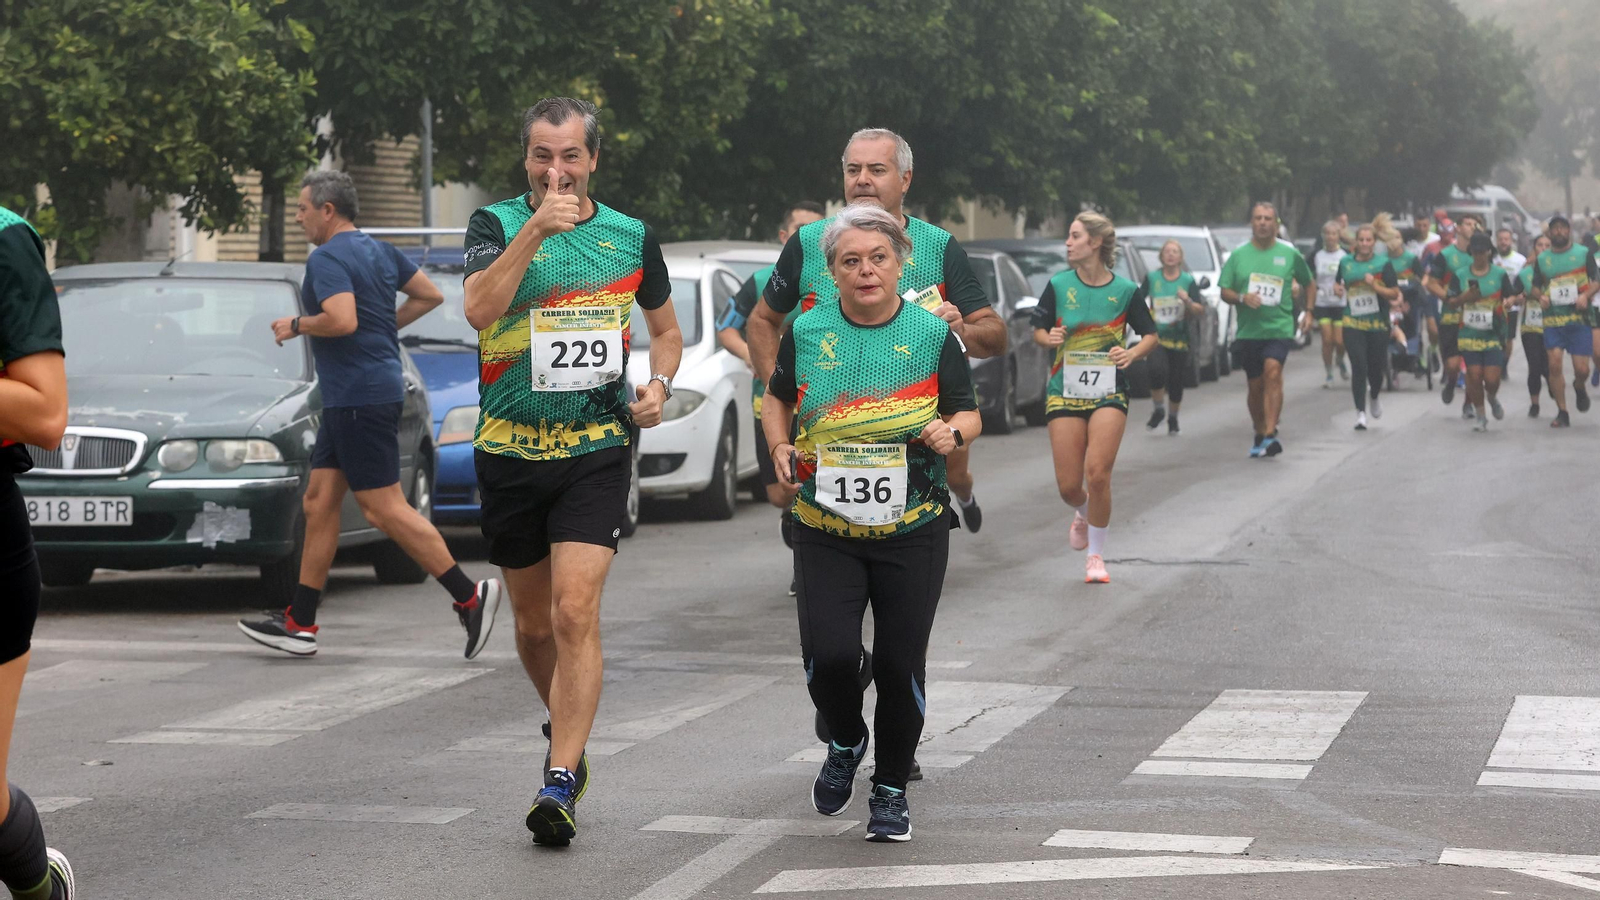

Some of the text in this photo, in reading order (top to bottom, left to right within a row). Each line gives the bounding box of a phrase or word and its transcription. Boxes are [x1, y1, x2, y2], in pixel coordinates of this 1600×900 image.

[1255, 285, 1276, 298] 212
[541, 309, 576, 317] CARRERA
[550, 339, 608, 368] 229
[1078, 371, 1101, 386] 47
[827, 446, 900, 454] CARRERA SOLIDARIA
[834, 476, 892, 504] 136
[27, 501, 129, 522] 818 BTR
